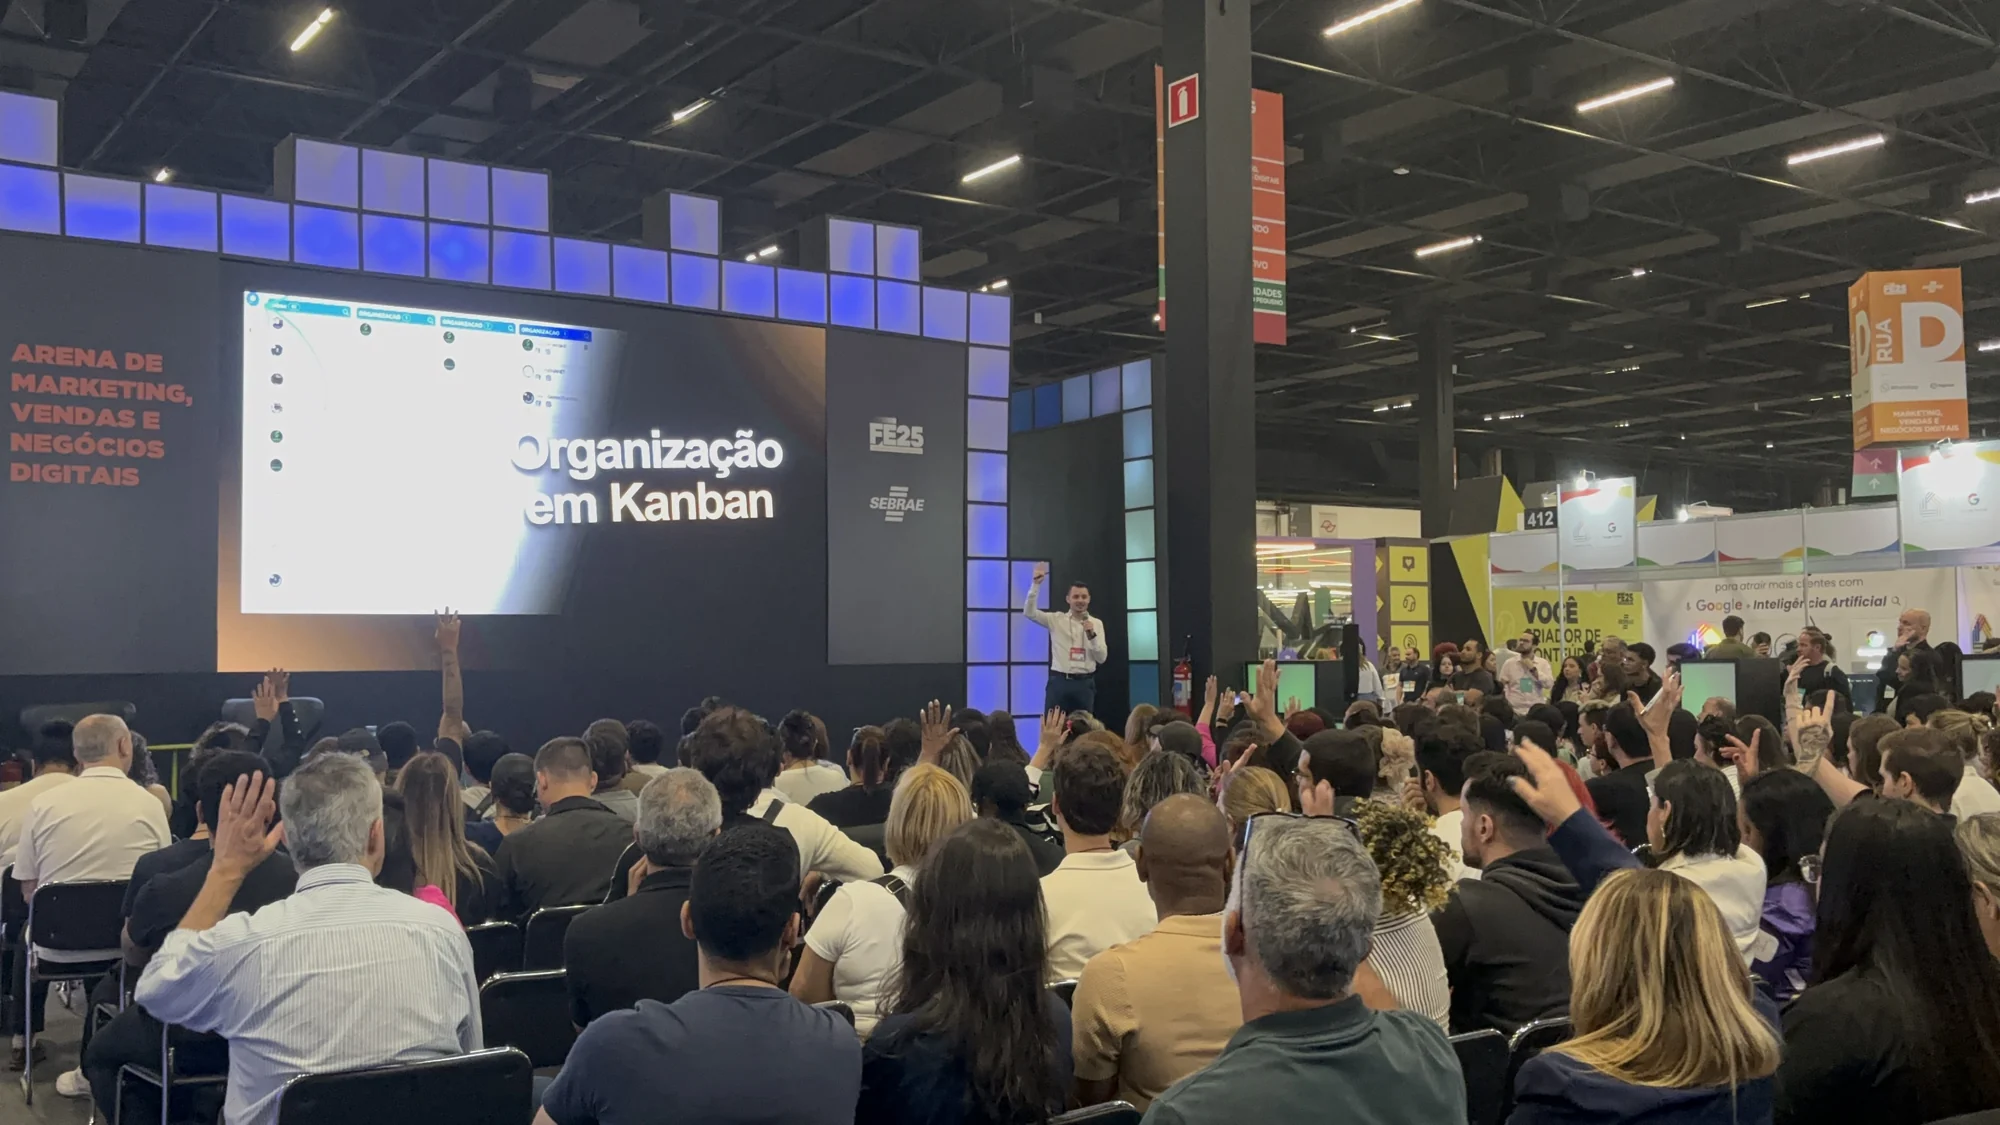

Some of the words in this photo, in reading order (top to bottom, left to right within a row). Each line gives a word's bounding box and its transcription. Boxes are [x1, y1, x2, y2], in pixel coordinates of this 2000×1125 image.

[1876, 318, 1892, 362] RUA
[1901, 302, 1964, 362] D
[11, 343, 118, 370] ARENA
[125, 352, 163, 373] DE
[11, 373, 193, 407] MARKETING,
[10, 402, 136, 429] VENDAS
[143, 410, 160, 430] E
[1892, 409, 1943, 418] MARKETING,
[1899, 417, 1932, 425] VENDAS
[10, 431, 165, 459] NEGÓCIOS
[869, 418, 924, 451] FE25
[512, 428, 784, 480] Organização
[10, 462, 140, 487] DIGITAIS
[524, 492, 598, 525] em
[610, 482, 774, 522] Kanban
[869, 496, 924, 511] SEBRAE
[1527, 511, 1554, 527] 412
[1715, 582, 1738, 594] para
[1740, 580, 1766, 591] atrair
[1769, 579, 1793, 590] mais
[1796, 578, 1836, 589] clentes
[1839, 577, 1863, 587] com
[1522, 595, 1578, 624] VOCÊ
[1696, 599, 1742, 614] Google
[1830, 596, 1887, 609] Artificial
[1532, 628, 1582, 644] RIADOR
[1585, 628, 1602, 643] DE
